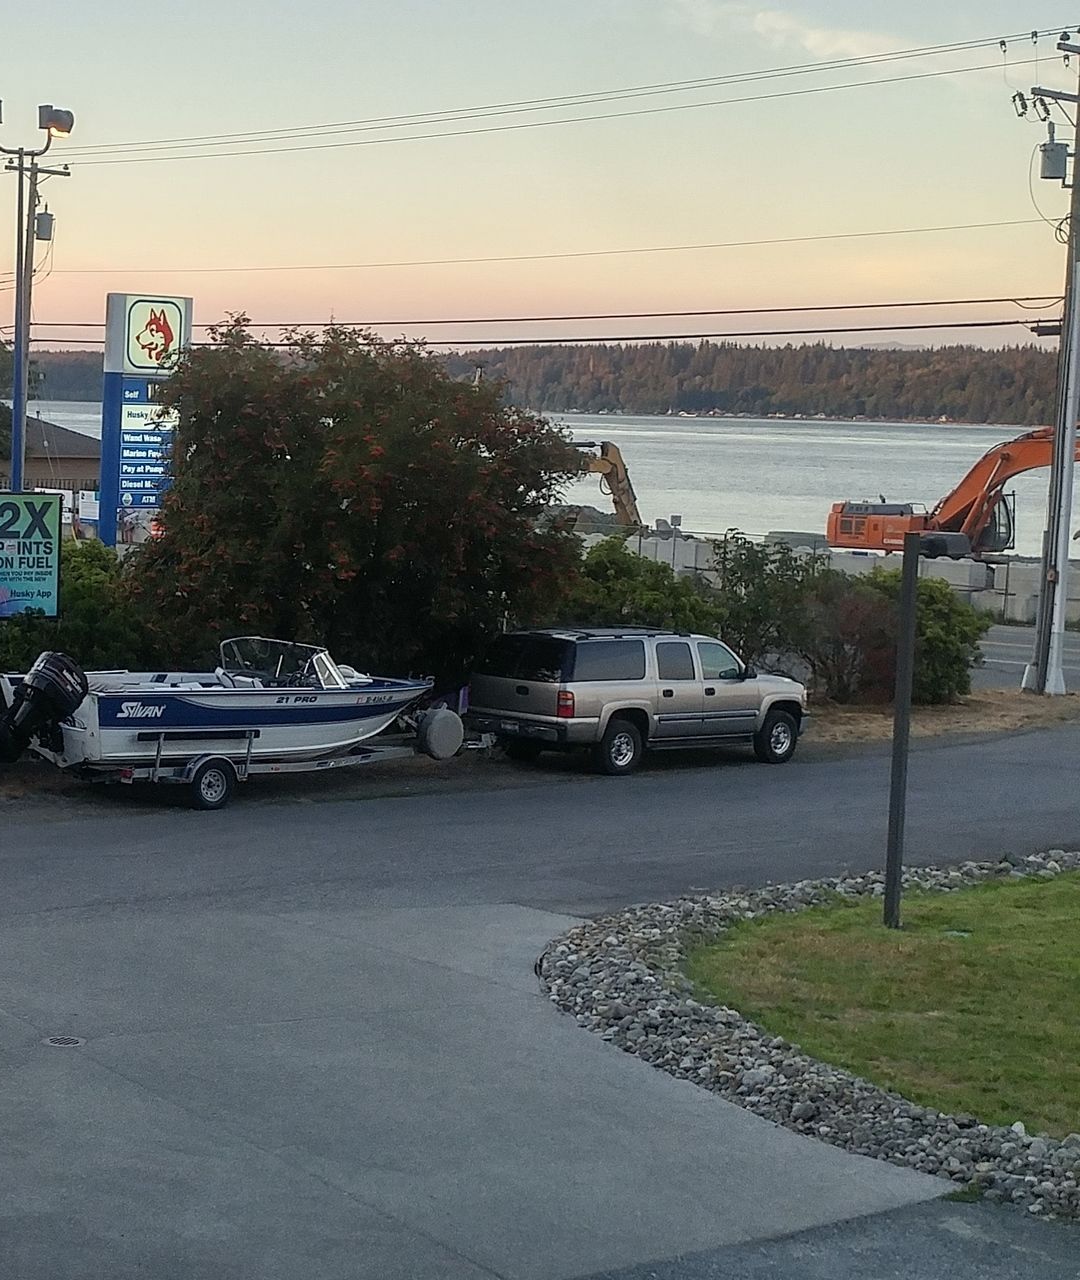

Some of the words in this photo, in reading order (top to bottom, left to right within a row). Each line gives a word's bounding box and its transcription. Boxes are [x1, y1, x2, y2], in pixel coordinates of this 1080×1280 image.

[124, 390, 139, 399] Self
[127, 410, 148, 420] Husky
[147, 450, 162, 458] Fu
[122, 464, 135, 473] Pay
[145, 465, 164, 473] Pump
[121, 480, 144, 488] Diesel
[141, 495, 156, 503] ATM
[18, 556, 53, 569] FUEL
[10, 589, 35, 599] Husky
[36, 589, 52, 599] App
[276, 696, 289, 704] 21
[293, 696, 318, 704] PRO
[116, 701, 166, 718] SYLVAN
